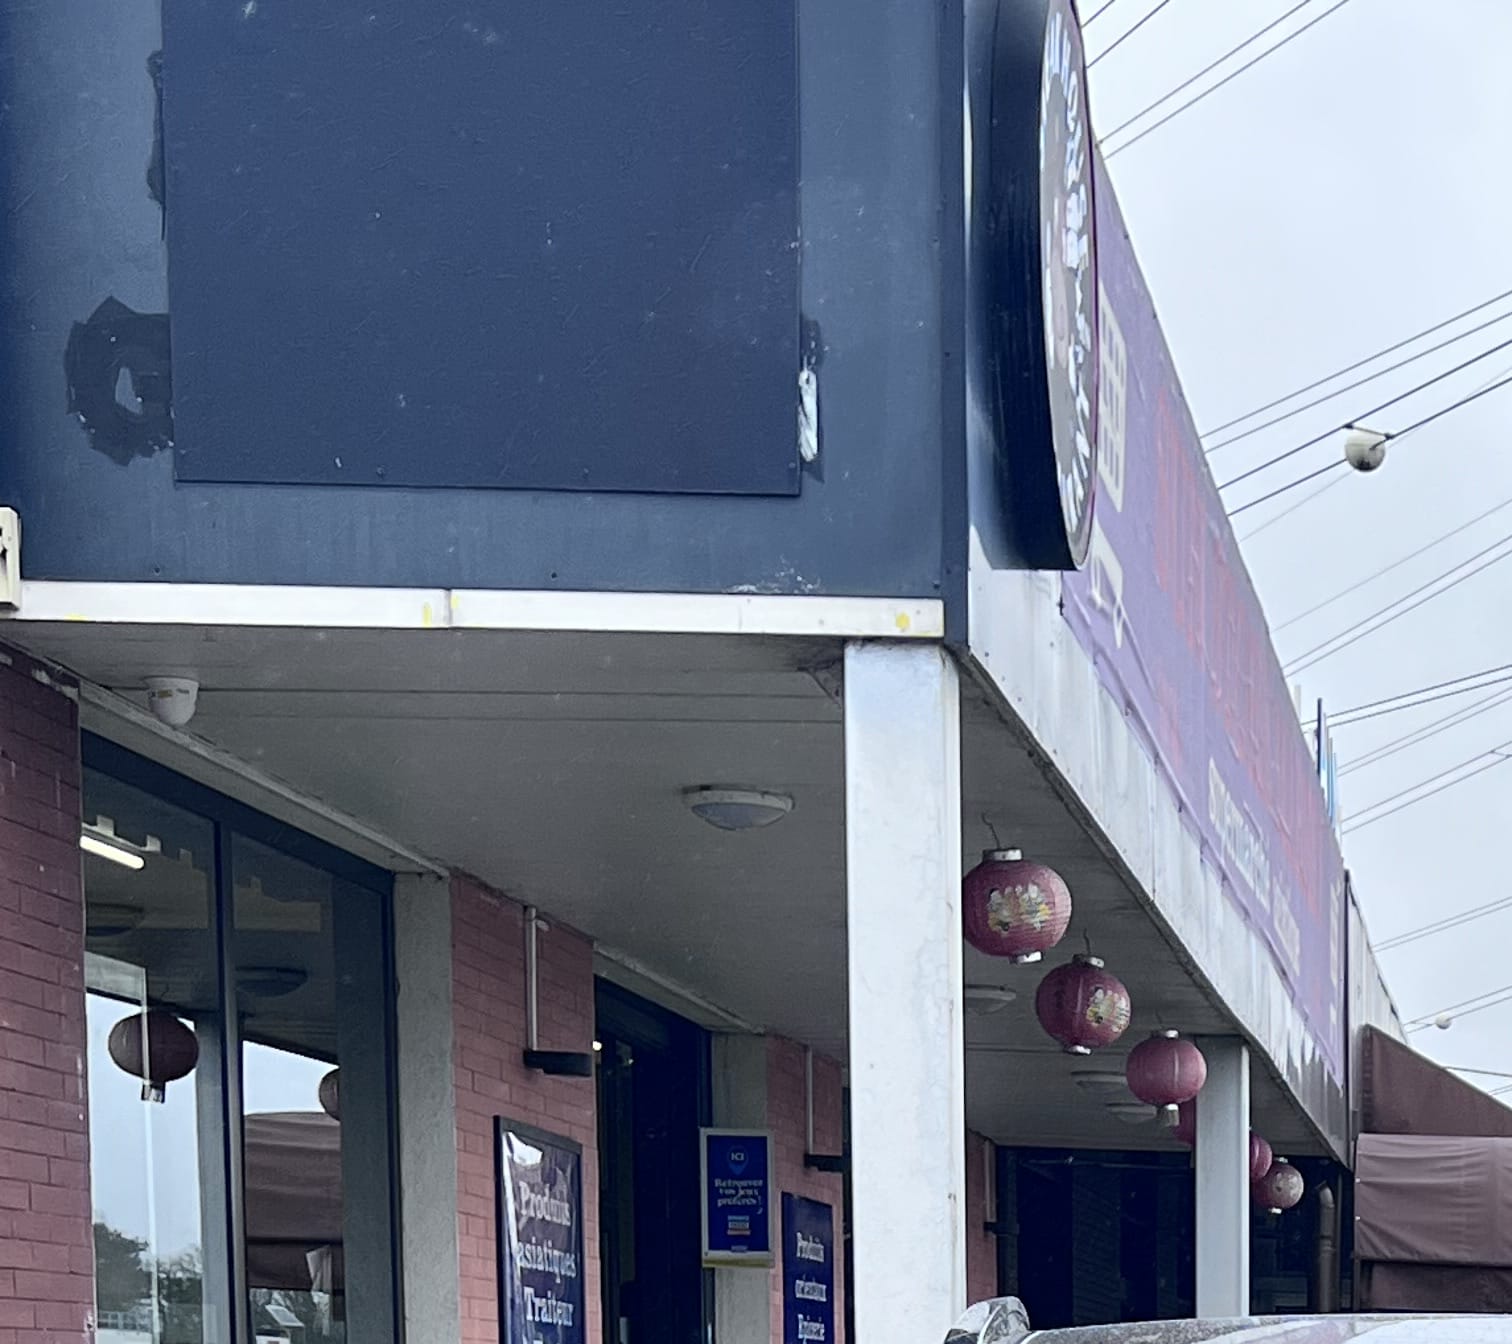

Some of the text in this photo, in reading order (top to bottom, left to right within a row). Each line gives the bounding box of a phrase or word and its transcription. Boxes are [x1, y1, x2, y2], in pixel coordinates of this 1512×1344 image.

[518, 1180, 571, 1226] Produits
[516, 1237, 577, 1284] asiatiques
[524, 1287, 574, 1327] Traiteur
